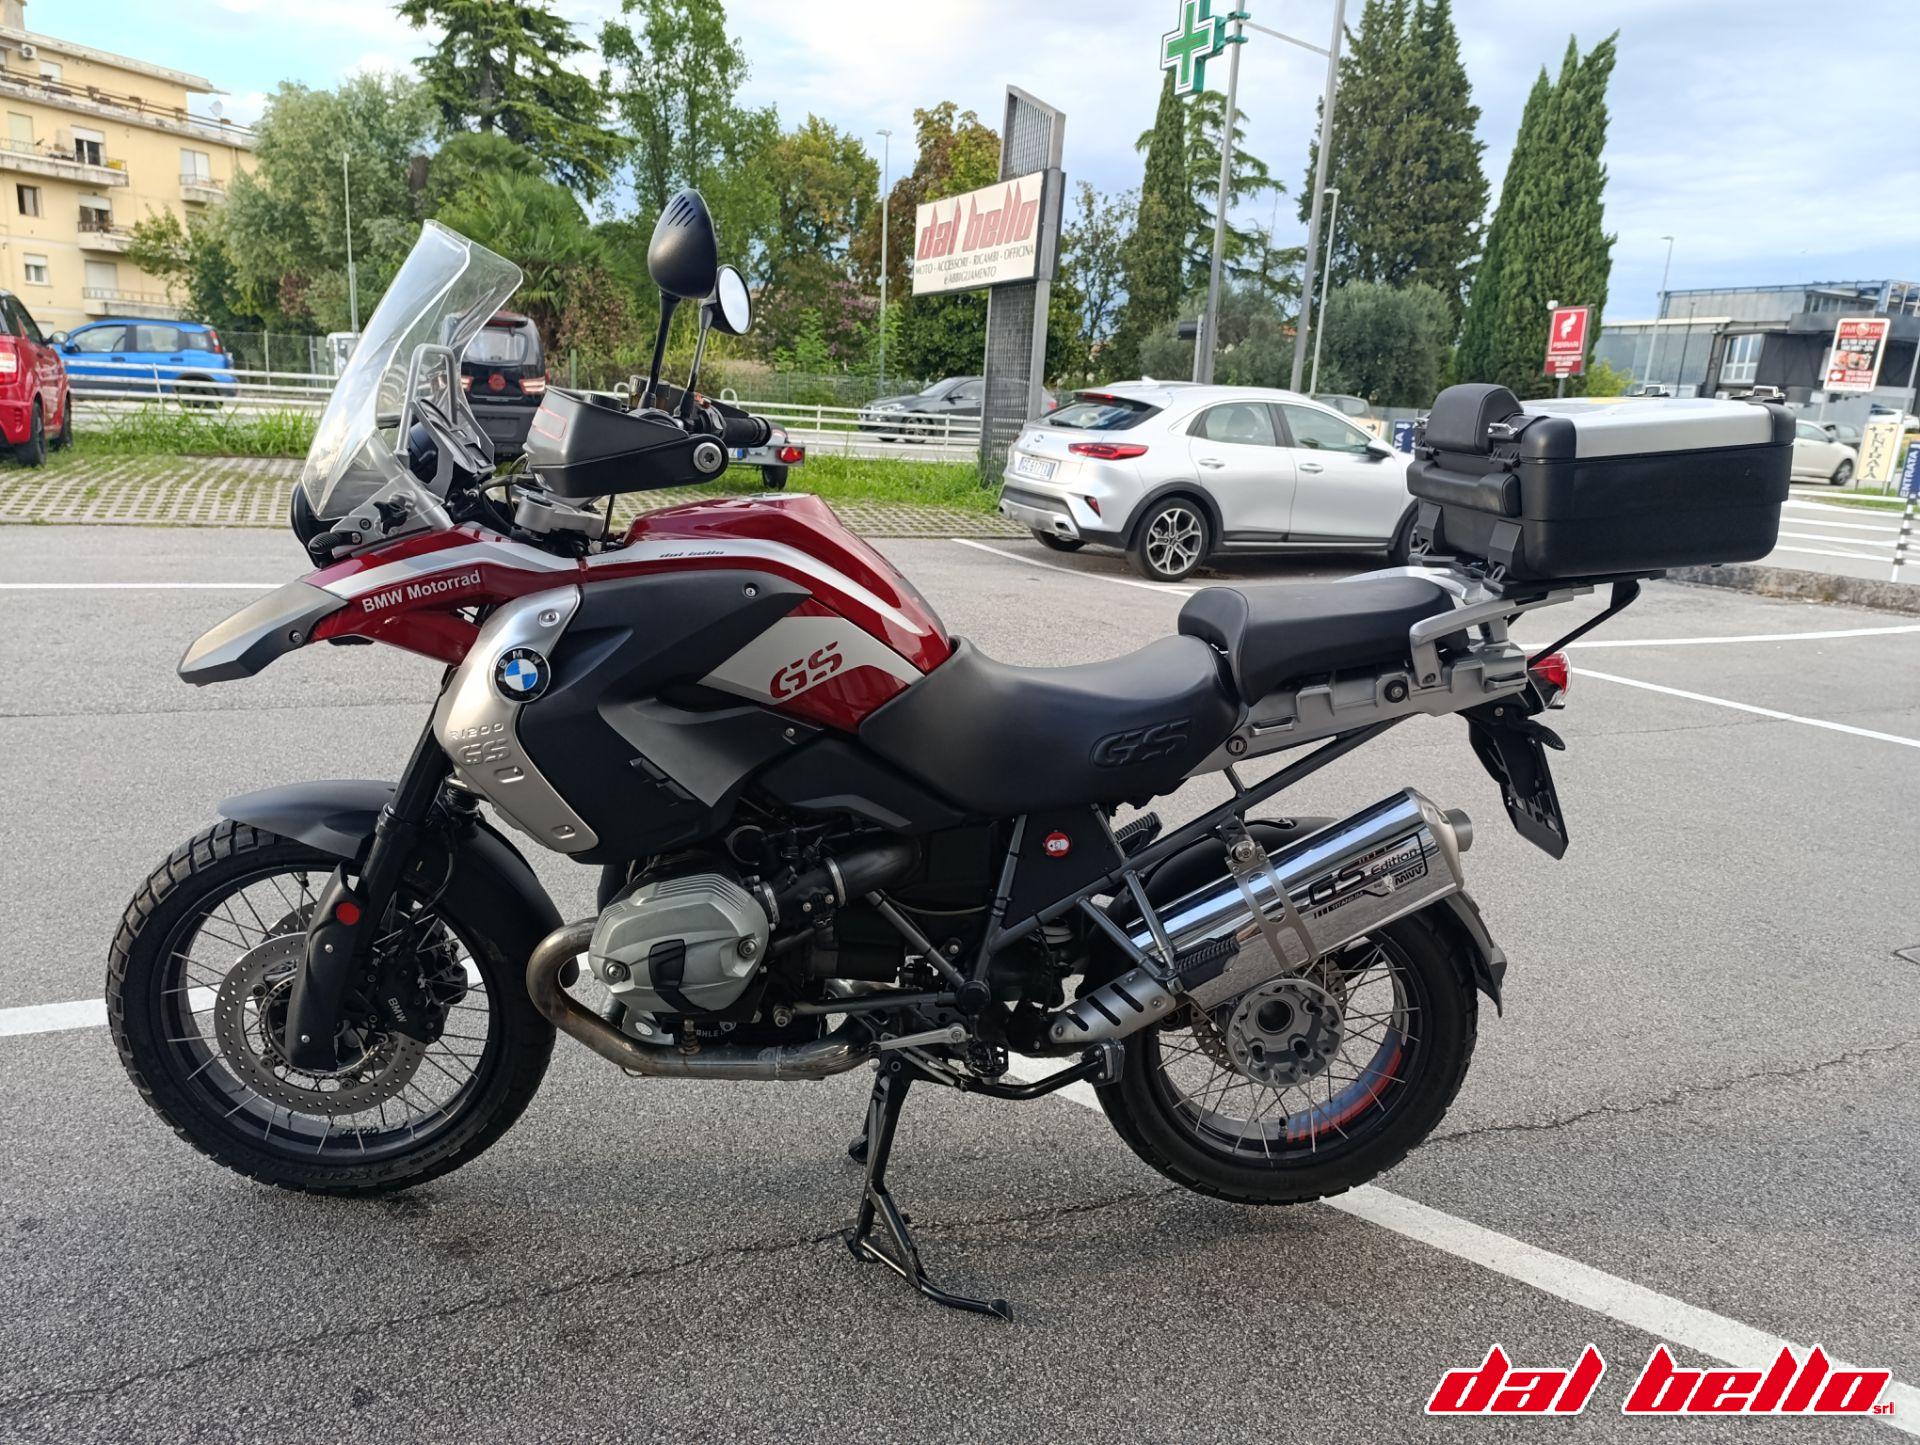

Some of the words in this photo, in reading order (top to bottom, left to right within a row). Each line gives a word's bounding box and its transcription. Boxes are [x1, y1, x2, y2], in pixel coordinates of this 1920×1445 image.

[917, 197, 962, 260] dal
[962, 181, 1038, 252] bello
[915, 263, 934, 275] MOTO
[937, 257, 969, 273] ACCESSORI
[973, 251, 1000, 266] RICAMBI
[1003, 243, 1034, 260] OFFICINA
[1900, 450, 1919, 498] ENTRATA
[361, 588, 403, 613] BMW
[406, 569, 481, 600] Motorrad
[498, 648, 542, 670] BMW
[769, 641, 843, 698] GS
[448, 722, 505, 740] R1200
[459, 737, 512, 765] GS
[1091, 718, 1192, 767] GS
[1308, 857, 1367, 906] GS
[1370, 847, 1419, 876] Edition
[387, 996, 408, 1022] BMW
